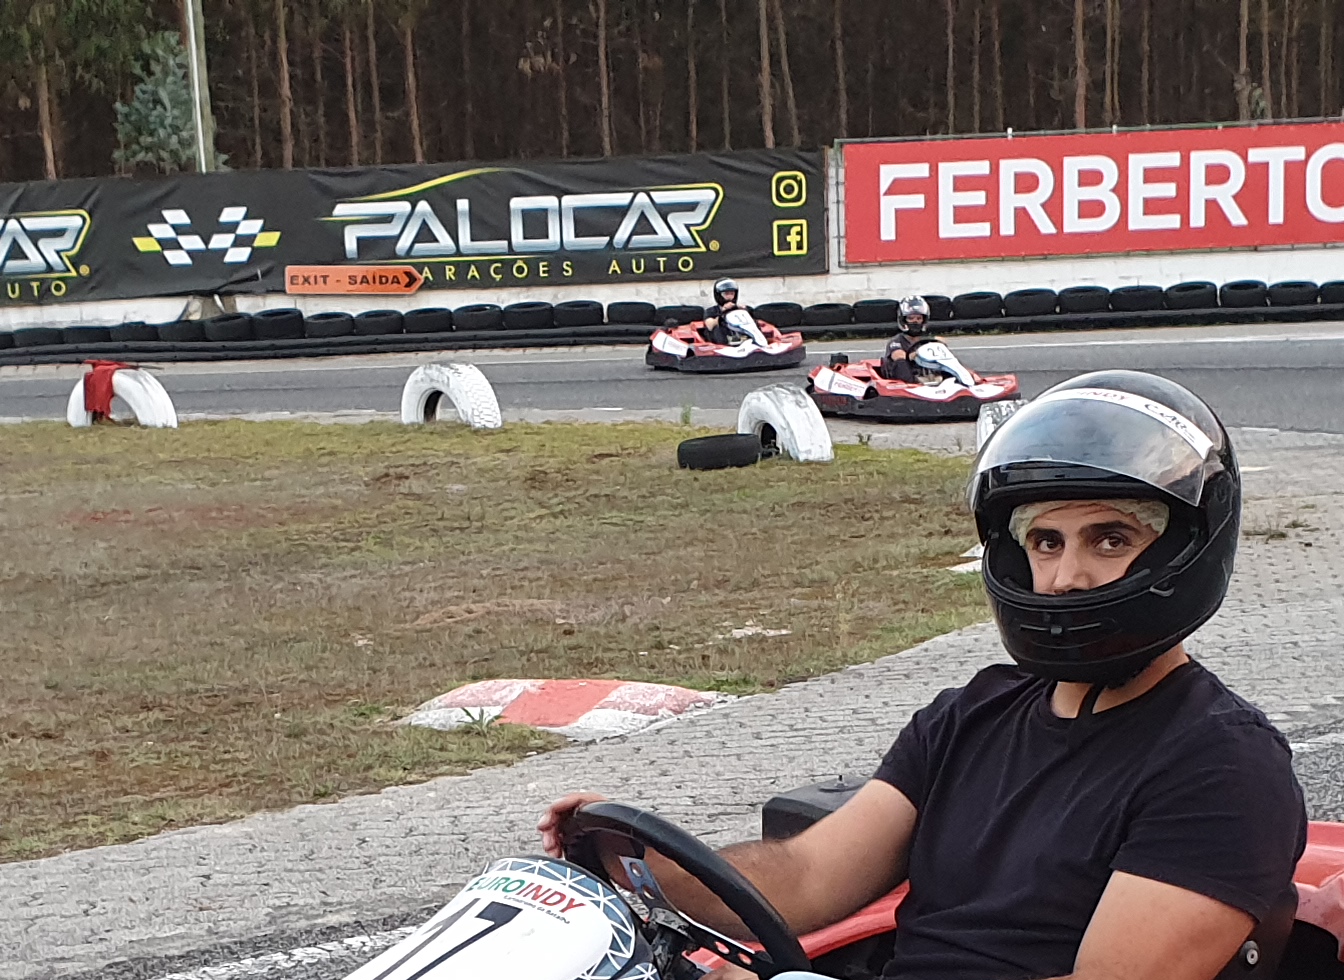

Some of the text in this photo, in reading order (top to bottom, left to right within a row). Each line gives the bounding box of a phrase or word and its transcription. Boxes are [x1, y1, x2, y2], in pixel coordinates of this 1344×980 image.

[331, 188, 717, 259] PALOCAR
[289, 273, 327, 288] EXIT
[347, 269, 402, 288] SAÍDA
[421, 254, 696, 284] ARAÇÕES AUTO
[467, 876, 587, 914] EUROINDY
